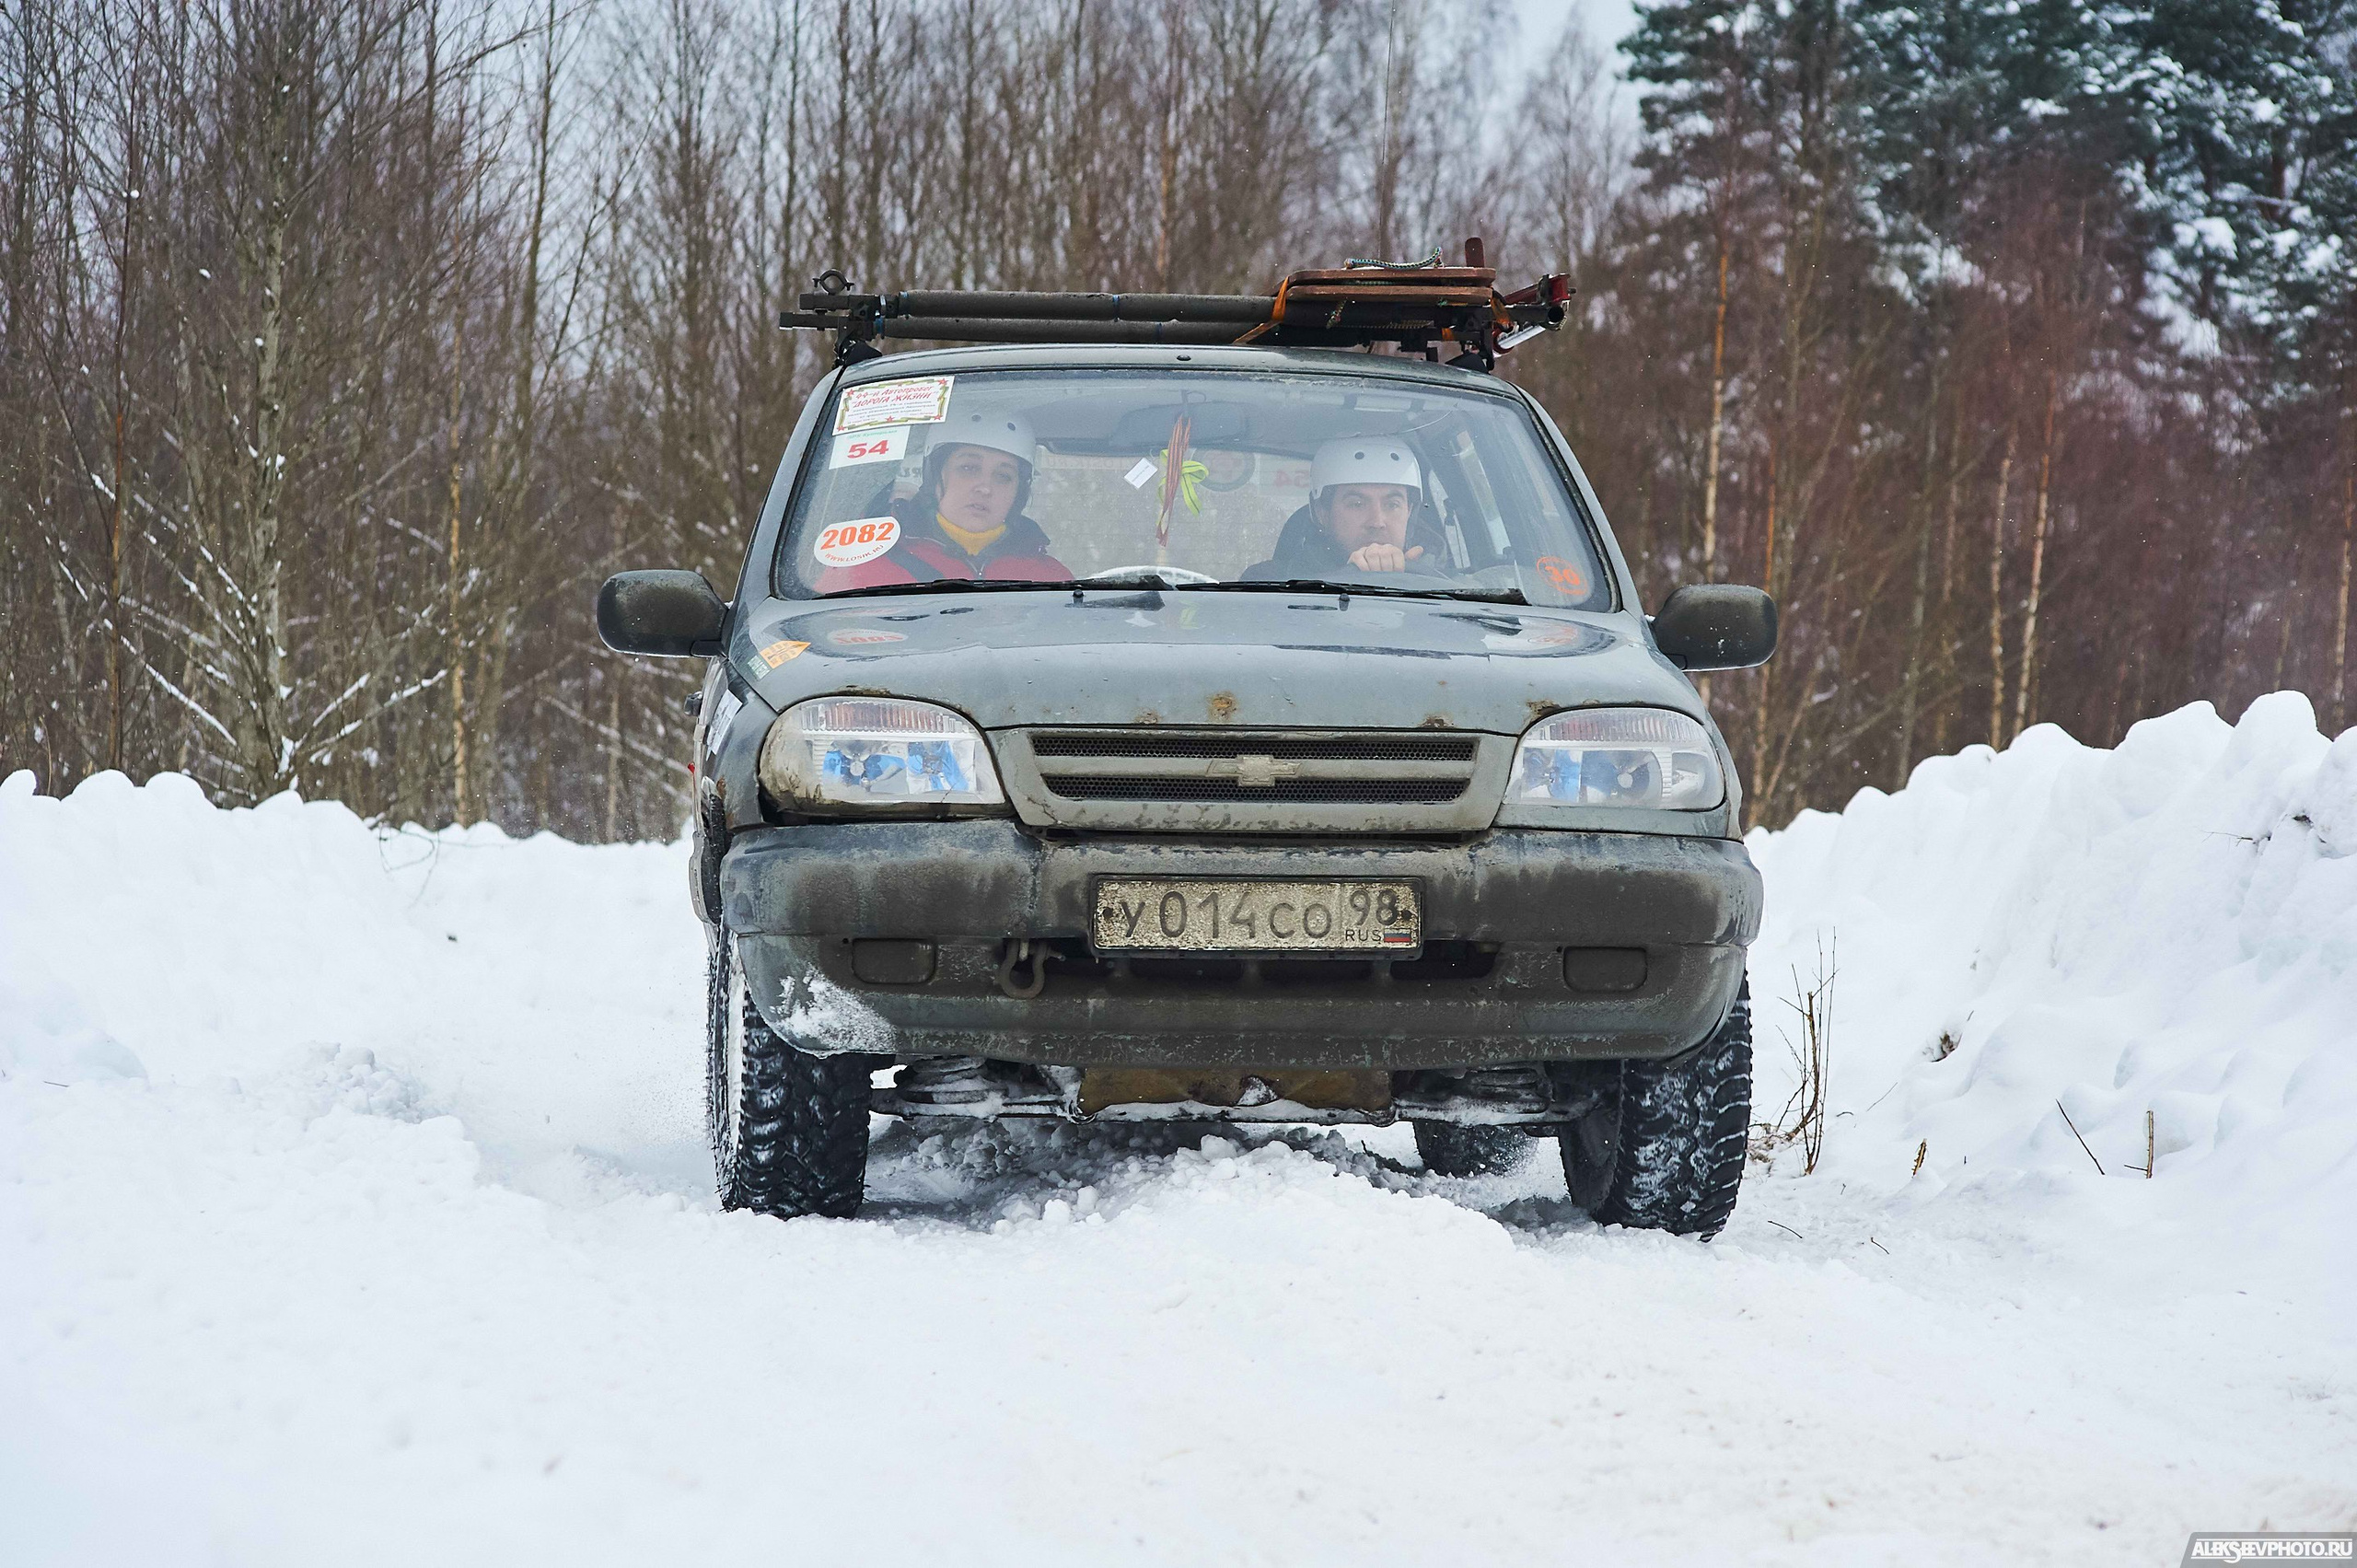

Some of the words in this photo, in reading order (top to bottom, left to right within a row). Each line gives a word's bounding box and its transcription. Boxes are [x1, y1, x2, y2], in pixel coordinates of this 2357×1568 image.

[847, 440, 889, 459] 54
[820, 522, 895, 550] 2082
[1349, 889, 1398, 926] 98
[1345, 928, 1382, 942] RUS
